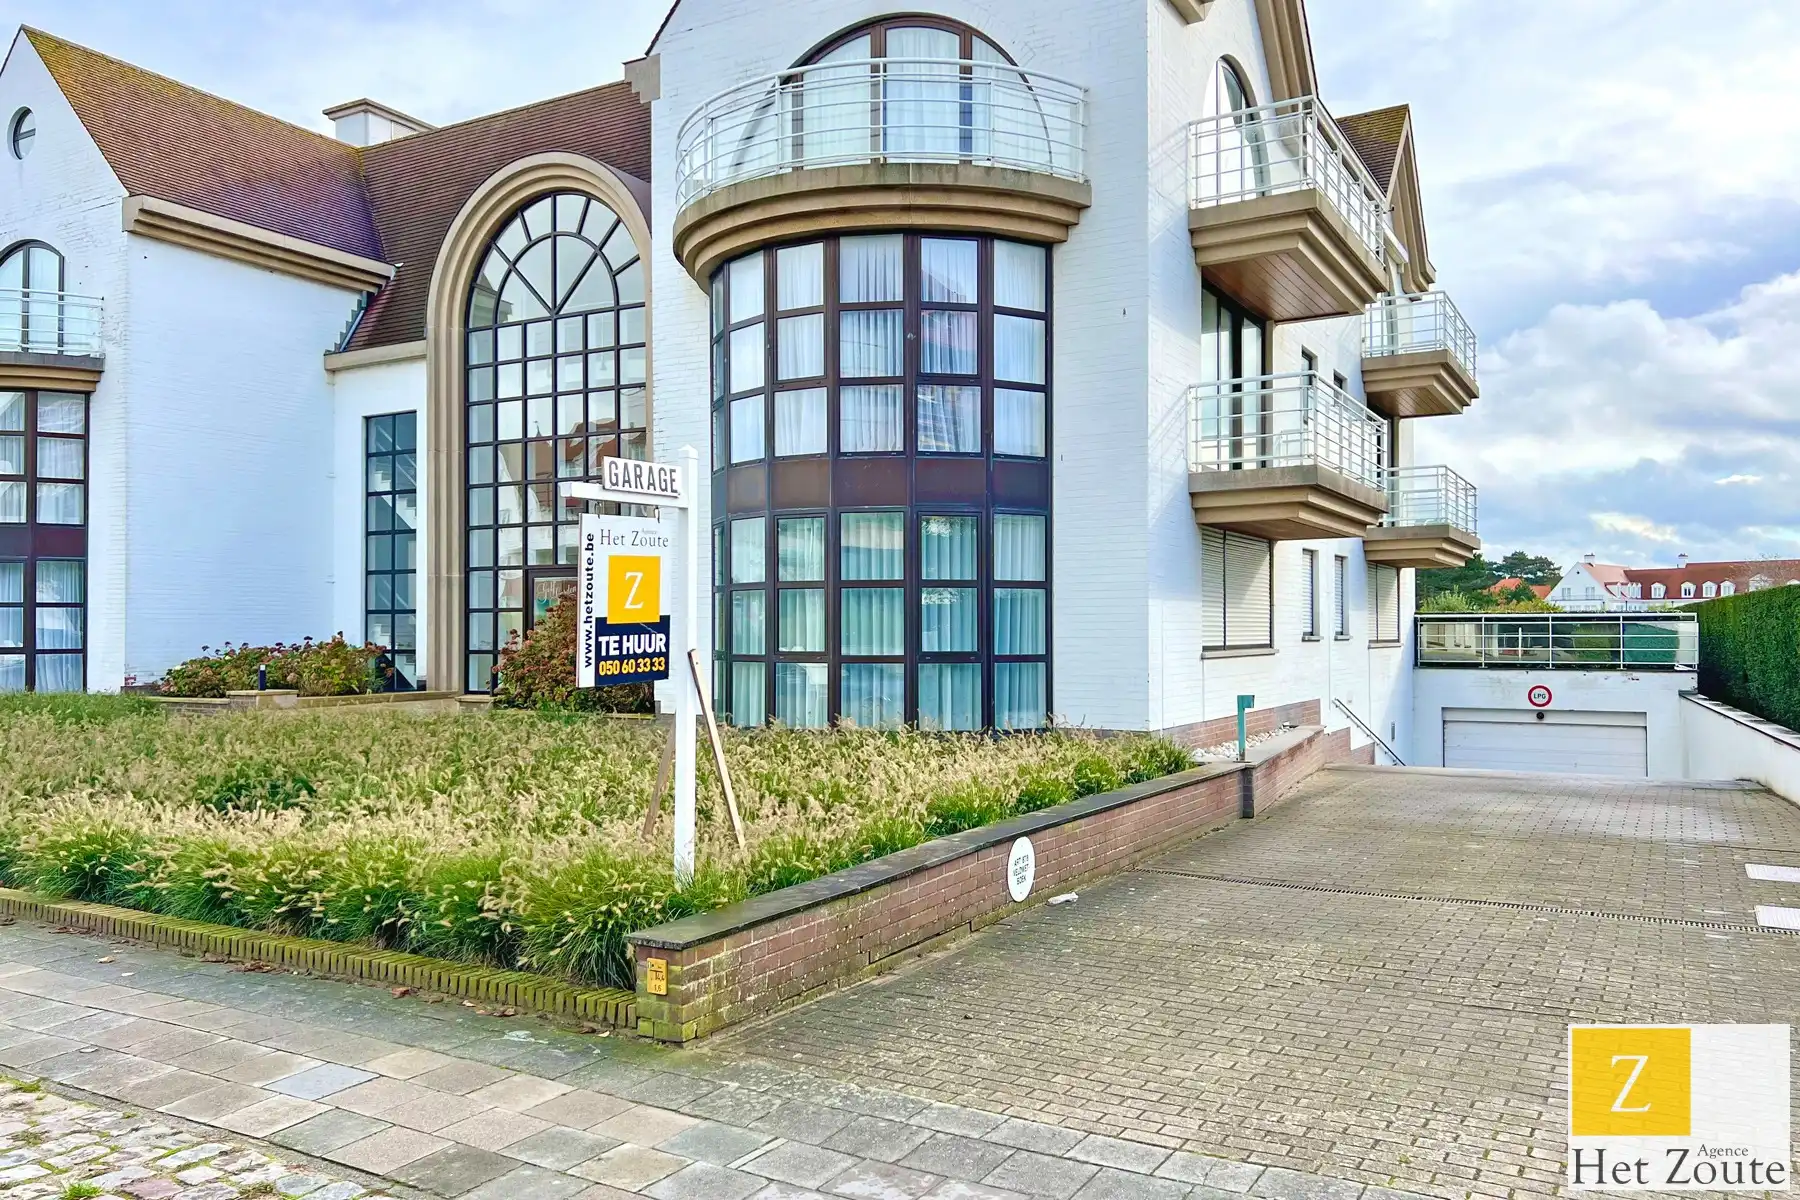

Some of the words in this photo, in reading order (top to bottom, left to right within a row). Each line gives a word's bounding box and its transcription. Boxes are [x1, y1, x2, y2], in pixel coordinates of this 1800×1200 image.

[608, 460, 678, 493] GARAGE
[600, 528, 625, 546] Het
[631, 530, 669, 548] Zoute
[583, 532, 594, 668] www.hetzoute.be
[623, 571, 643, 609] Z
[598, 635, 620, 656] TE
[622, 633, 667, 655] HUUR
[599, 660, 620, 676] 050
[622, 659, 635, 674] 60
[637, 658, 651, 673] 33
[652, 656, 665, 671] 33
